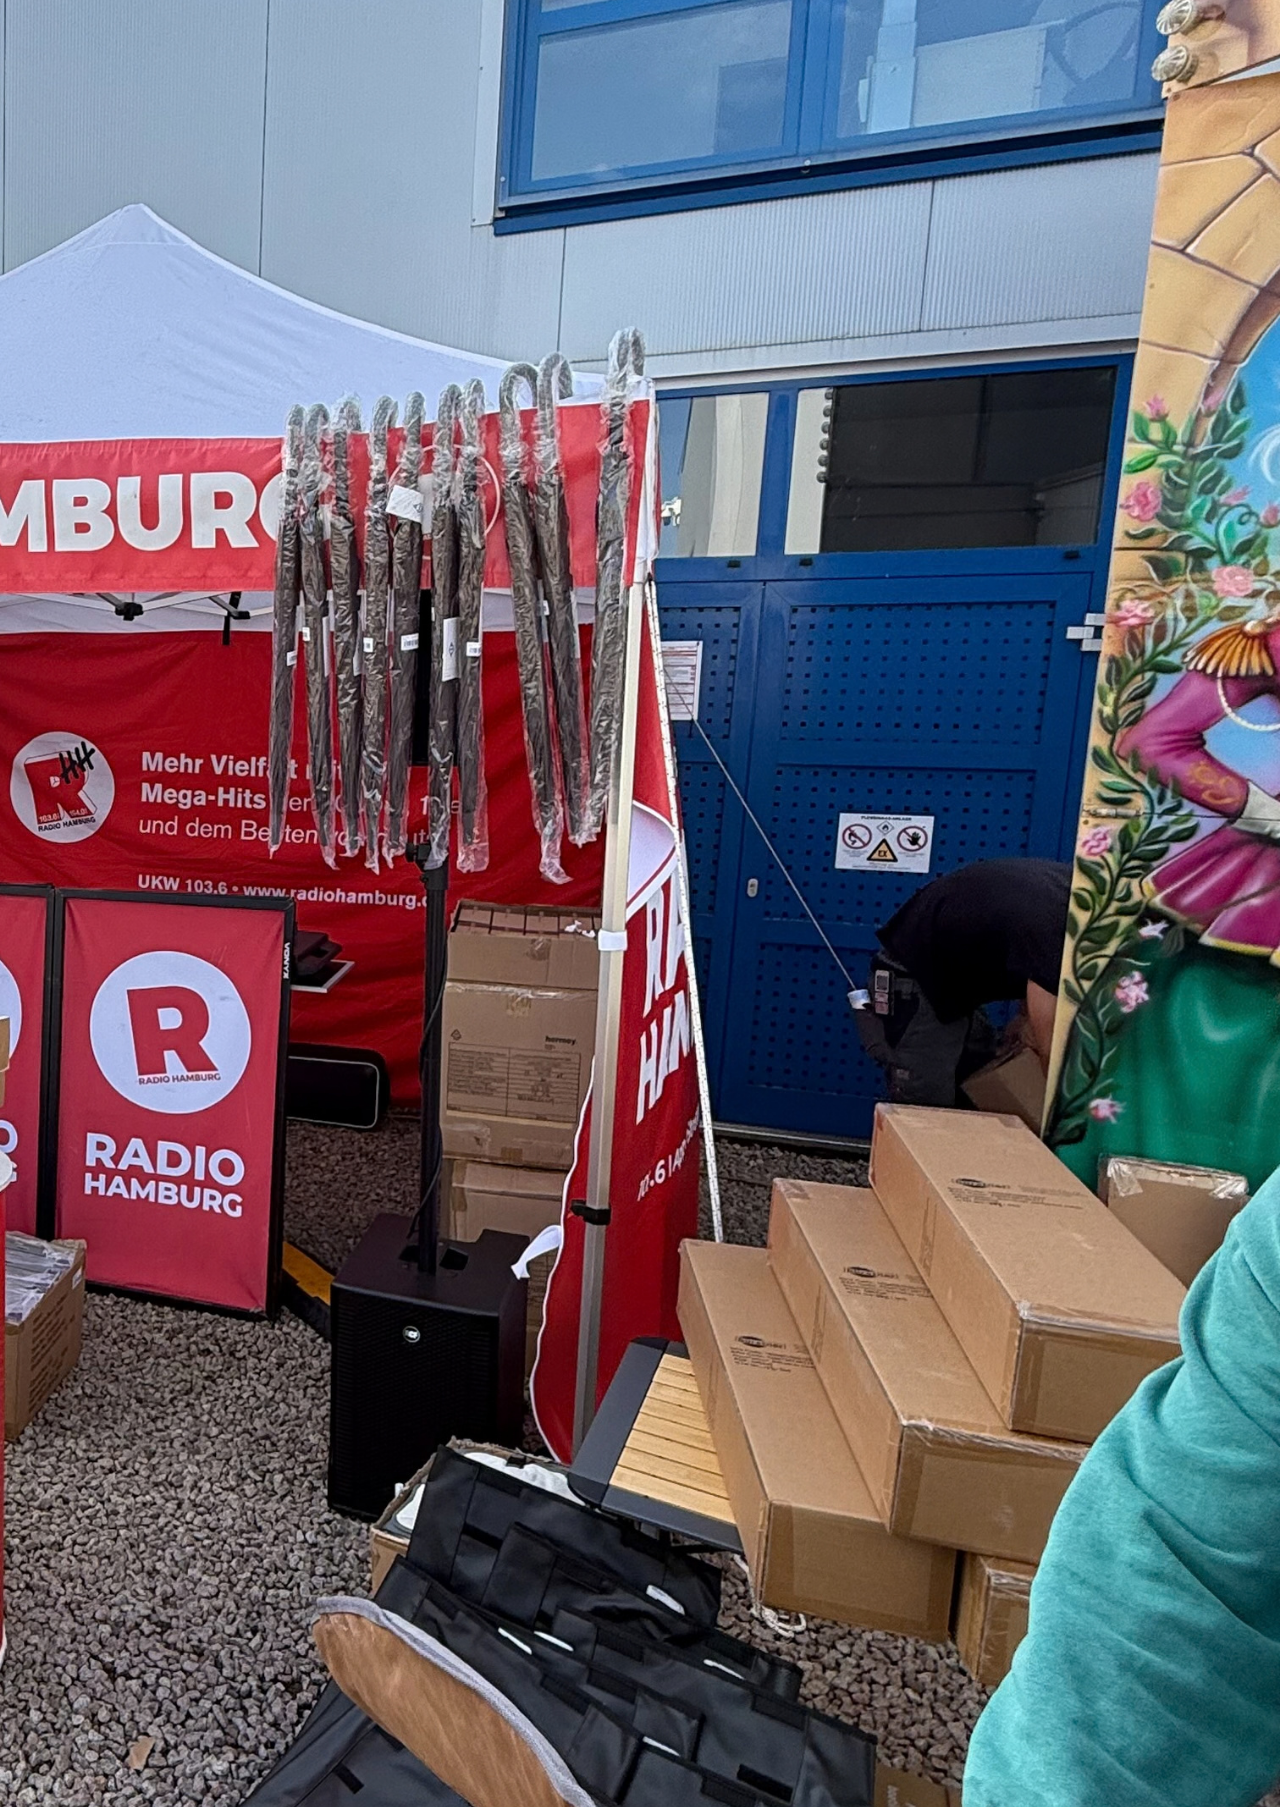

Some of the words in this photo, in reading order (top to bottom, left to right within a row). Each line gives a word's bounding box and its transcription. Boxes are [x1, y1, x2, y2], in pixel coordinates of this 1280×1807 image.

[141, 751, 203, 774] Mehr
[210, 754, 298, 780] Vielft
[140, 783, 266, 809] Mega-Hits
[38, 821, 61, 832] RADIO
[139, 815, 178, 836] und
[185, 817, 232, 839] dem
[240, 820, 318, 844] Beten
[138, 874, 179, 891] UKW
[185, 878, 228, 895] 103.6
[243, 885, 428, 911] www.radiohamburg.
[283, 942, 291, 980] VONYX
[127, 986, 218, 1075] R
[138, 1074, 170, 1085] RADIO
[172, 1072, 221, 1083] HAMBURG
[85, 1132, 245, 1186] RADIO
[84, 1172, 243, 1218] HAMBURG
